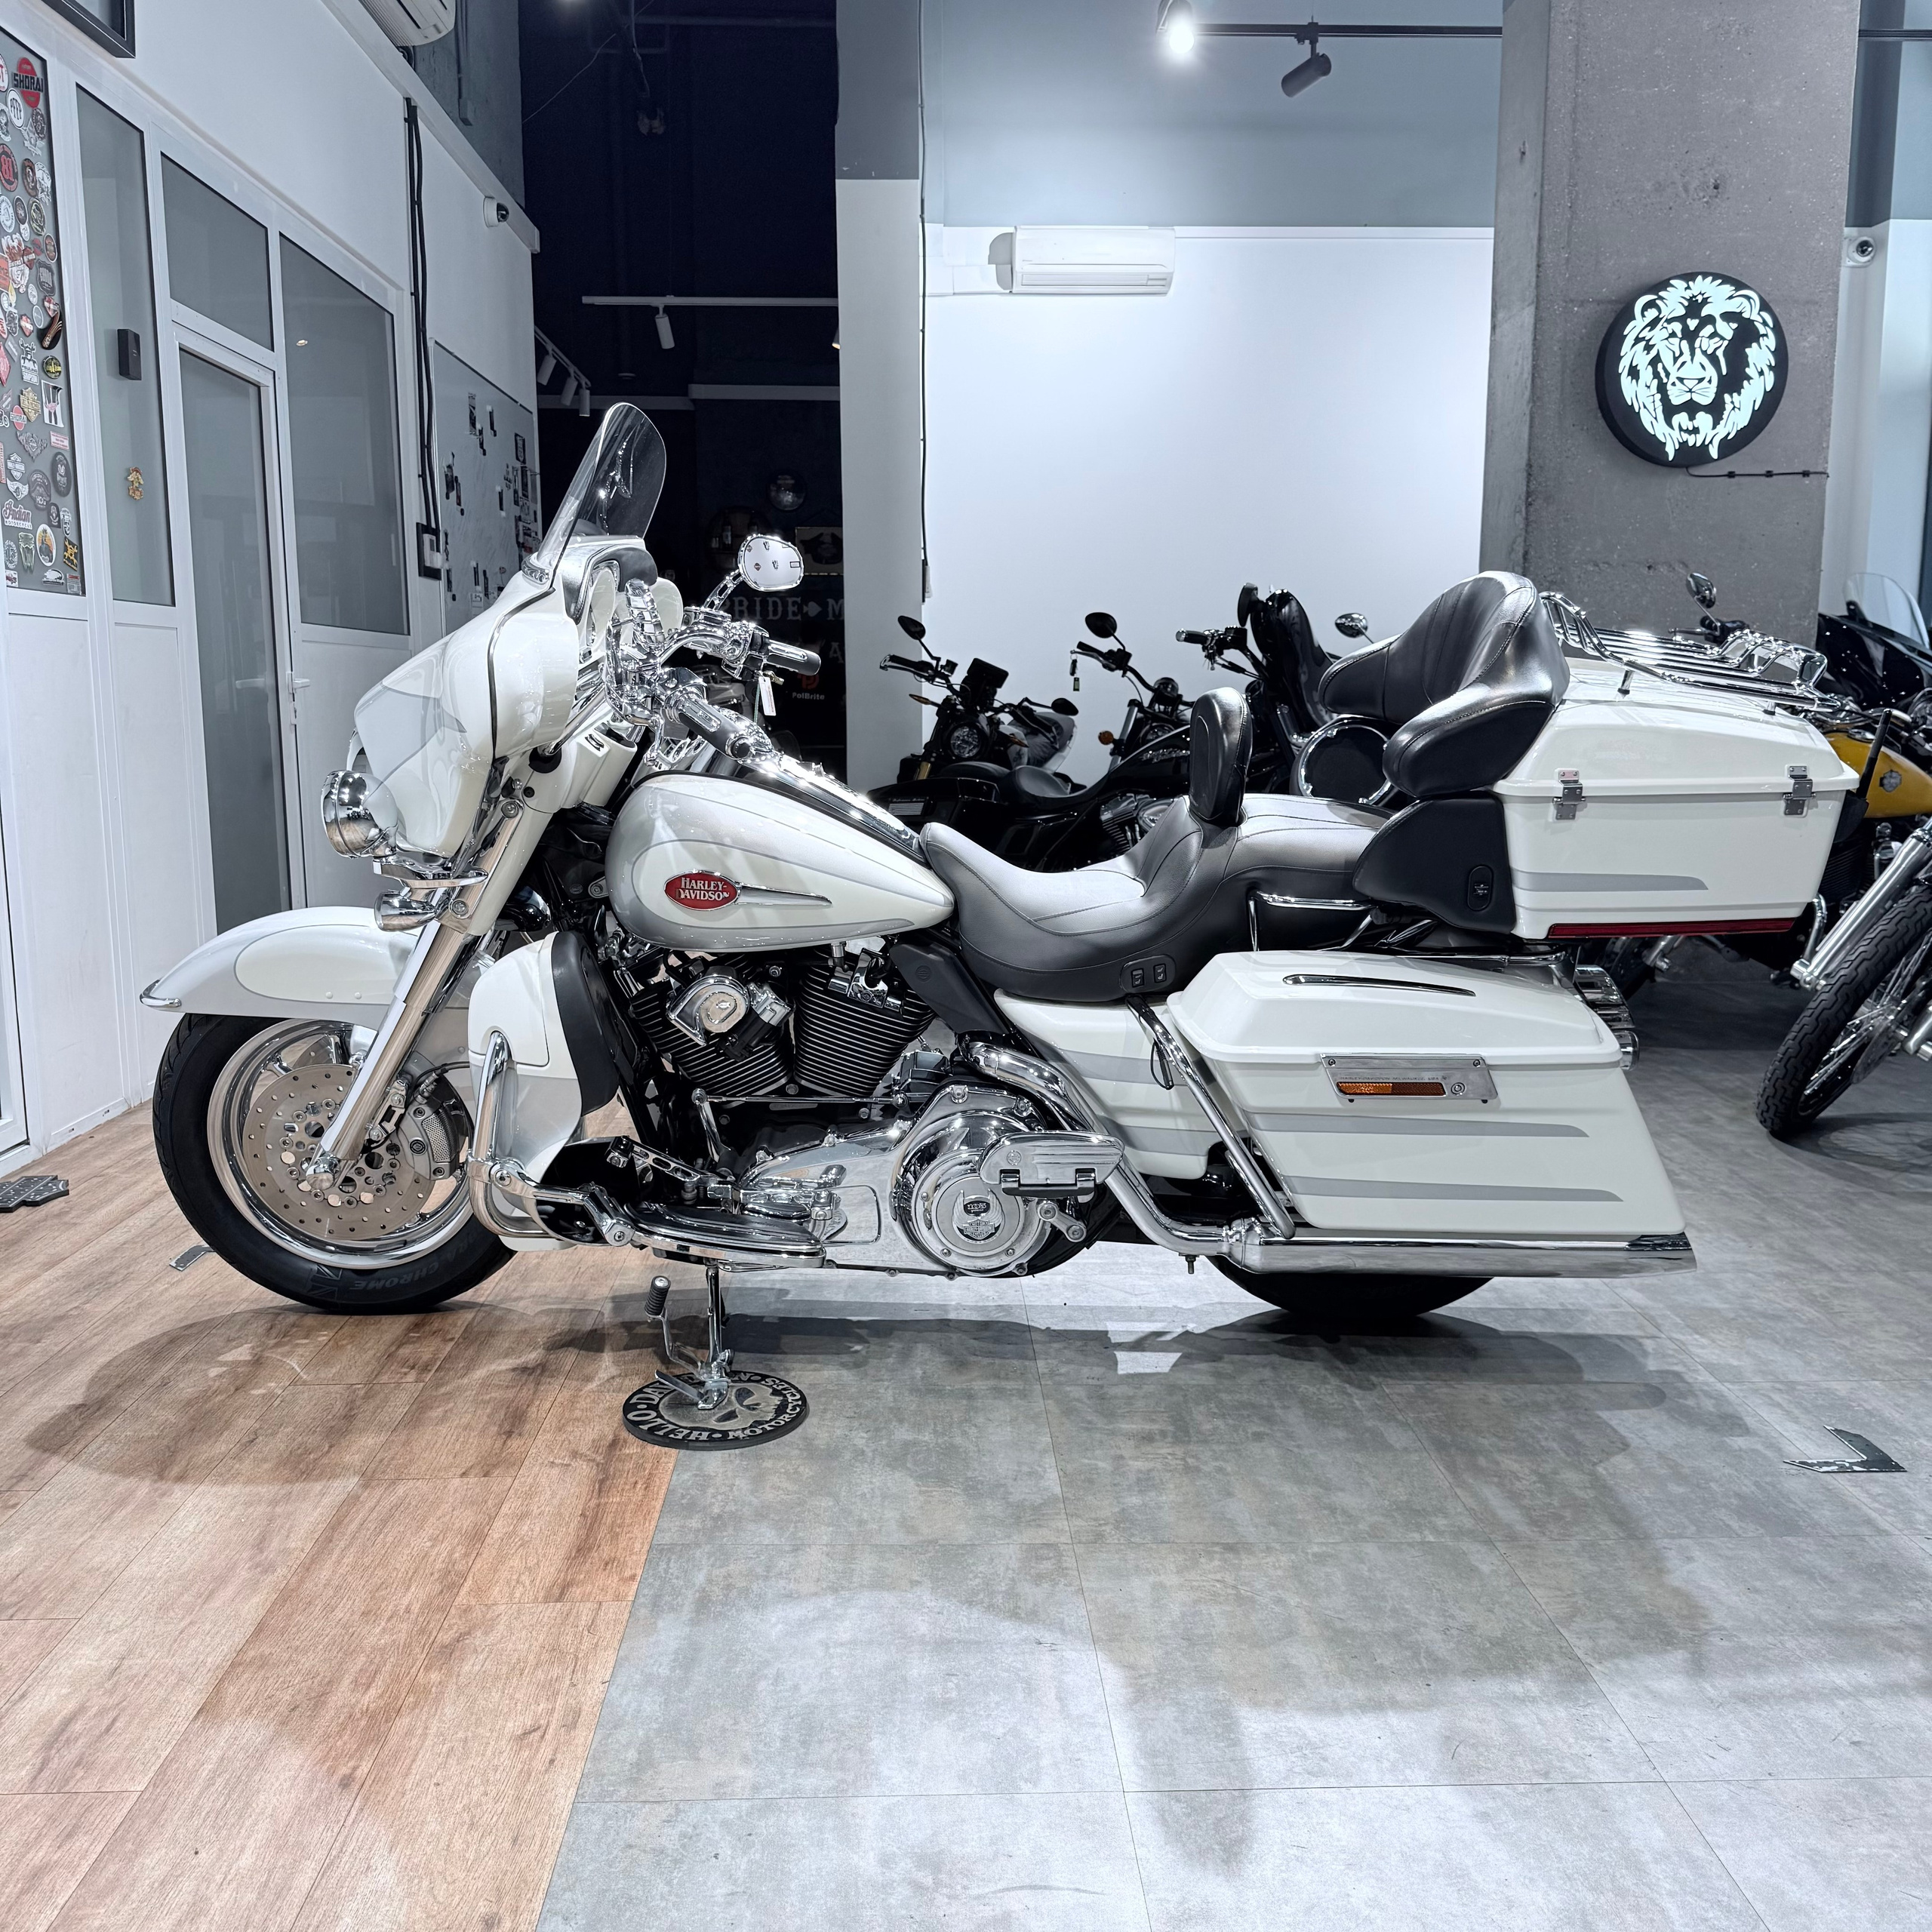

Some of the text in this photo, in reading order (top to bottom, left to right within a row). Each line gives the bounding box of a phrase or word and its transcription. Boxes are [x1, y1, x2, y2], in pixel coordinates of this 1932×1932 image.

[13, 72, 44, 92] SHORAI
[792, 691, 826, 700] PolBrite
[681, 877, 727, 891] HARLEY-
[675, 888, 730, 901] DAVIDSON
[349, 1261, 439, 1291] CHROME
[626, 1409, 709, 1441] HELLO
